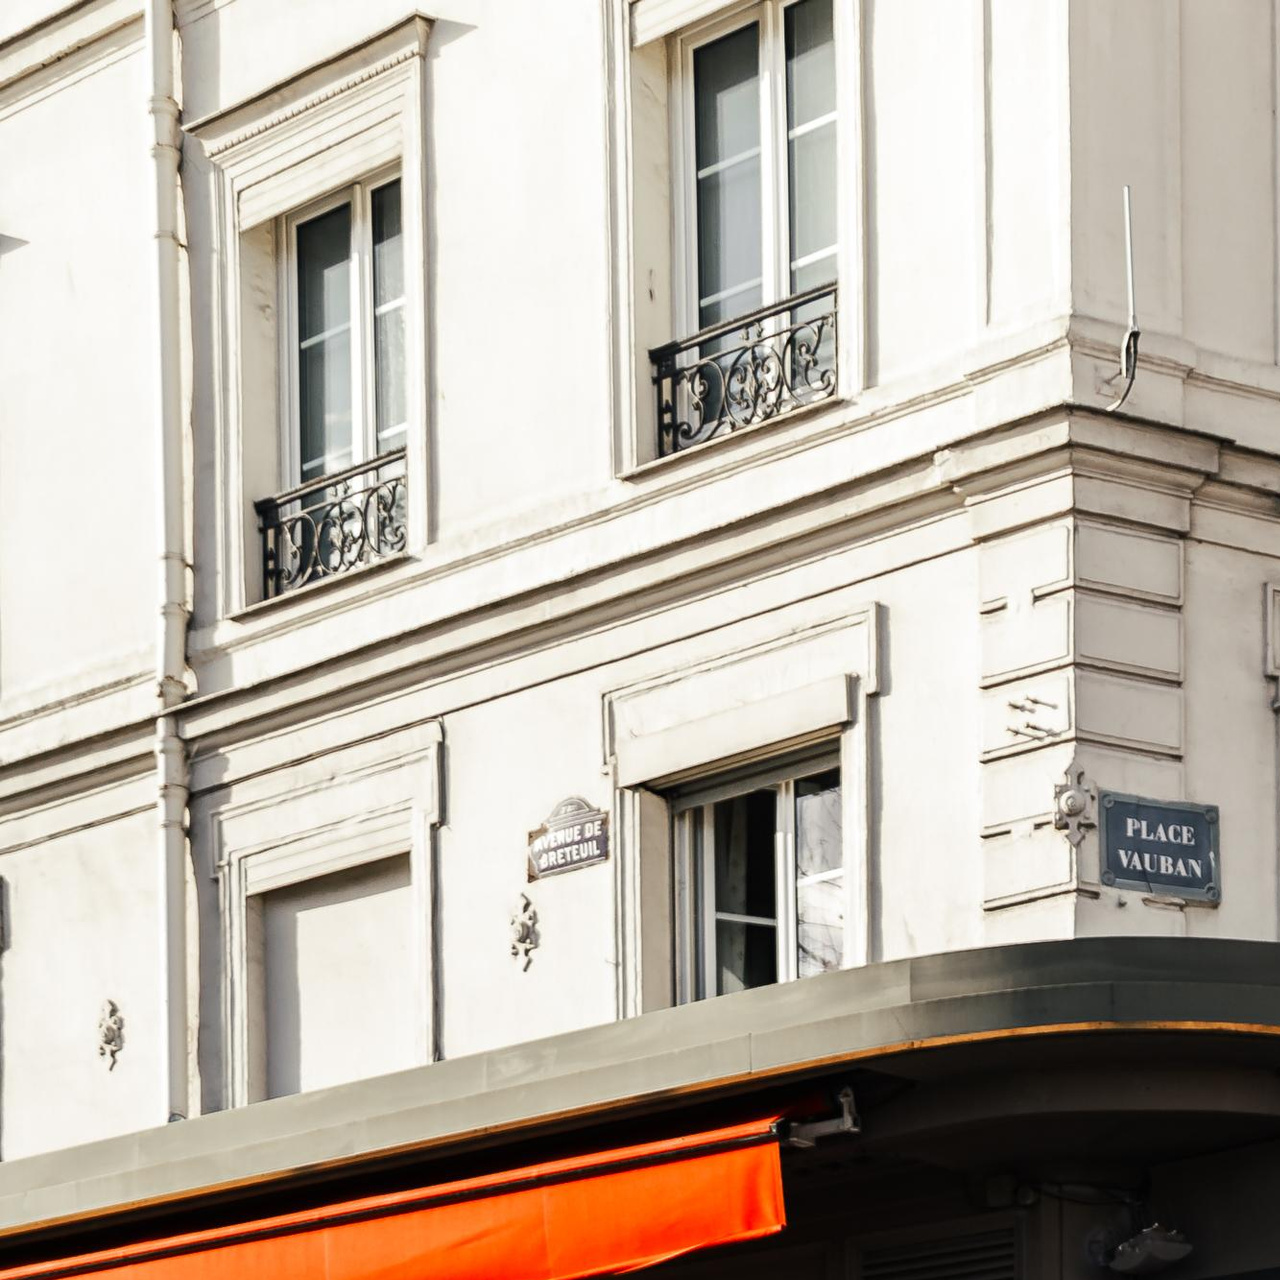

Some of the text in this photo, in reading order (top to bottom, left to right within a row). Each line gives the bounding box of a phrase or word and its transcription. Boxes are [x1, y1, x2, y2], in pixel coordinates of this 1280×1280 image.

[532, 820, 602, 853] AVENUE DE
[1126, 817, 1196, 846] PLACE
[539, 840, 601, 870] BRETEUIL
[1117, 848, 1203, 879] VAUBAN
